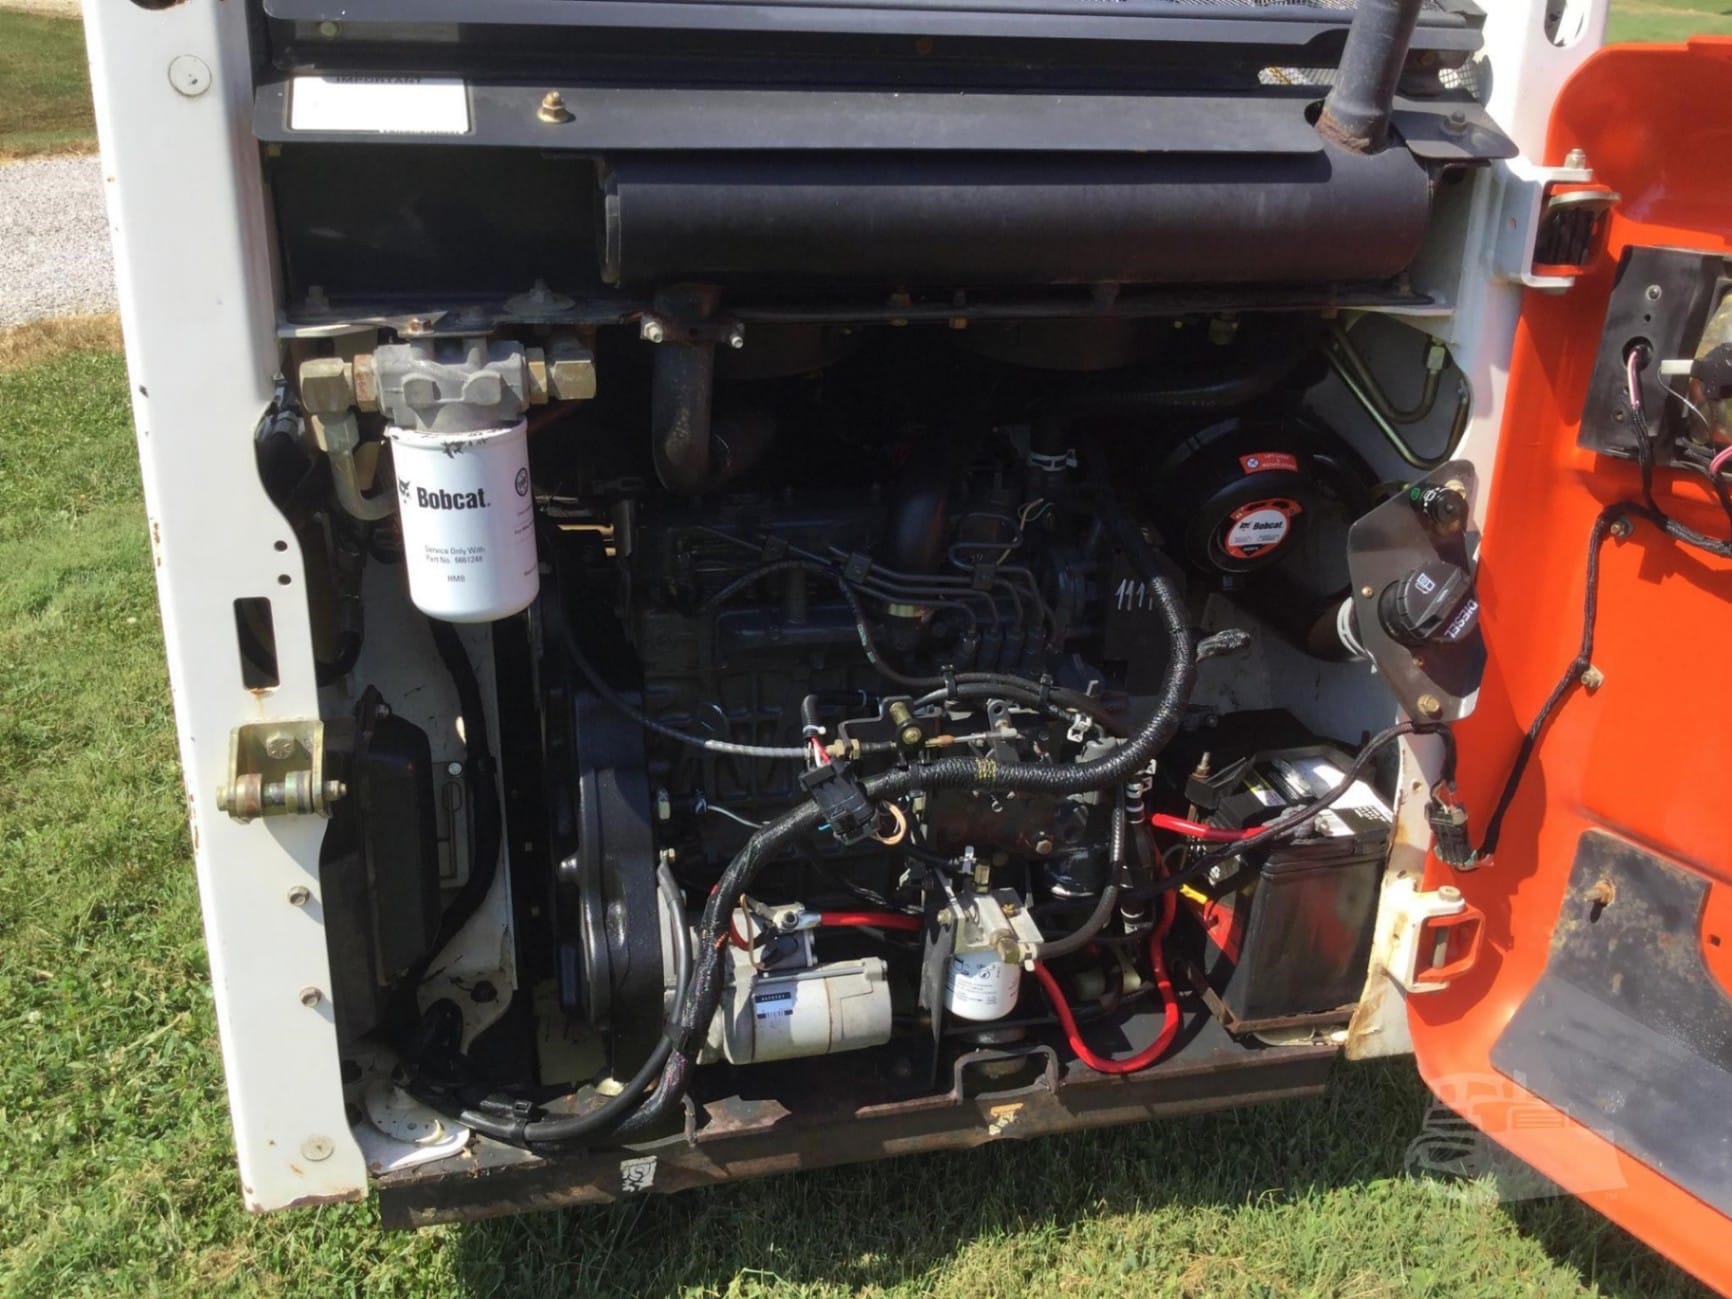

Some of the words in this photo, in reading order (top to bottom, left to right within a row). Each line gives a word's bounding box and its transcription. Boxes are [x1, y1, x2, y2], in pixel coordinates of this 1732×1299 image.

[424, 544, 448, 554] Service
[450, 547, 466, 555] Only
[1444, 600, 1479, 639] DIESEL
